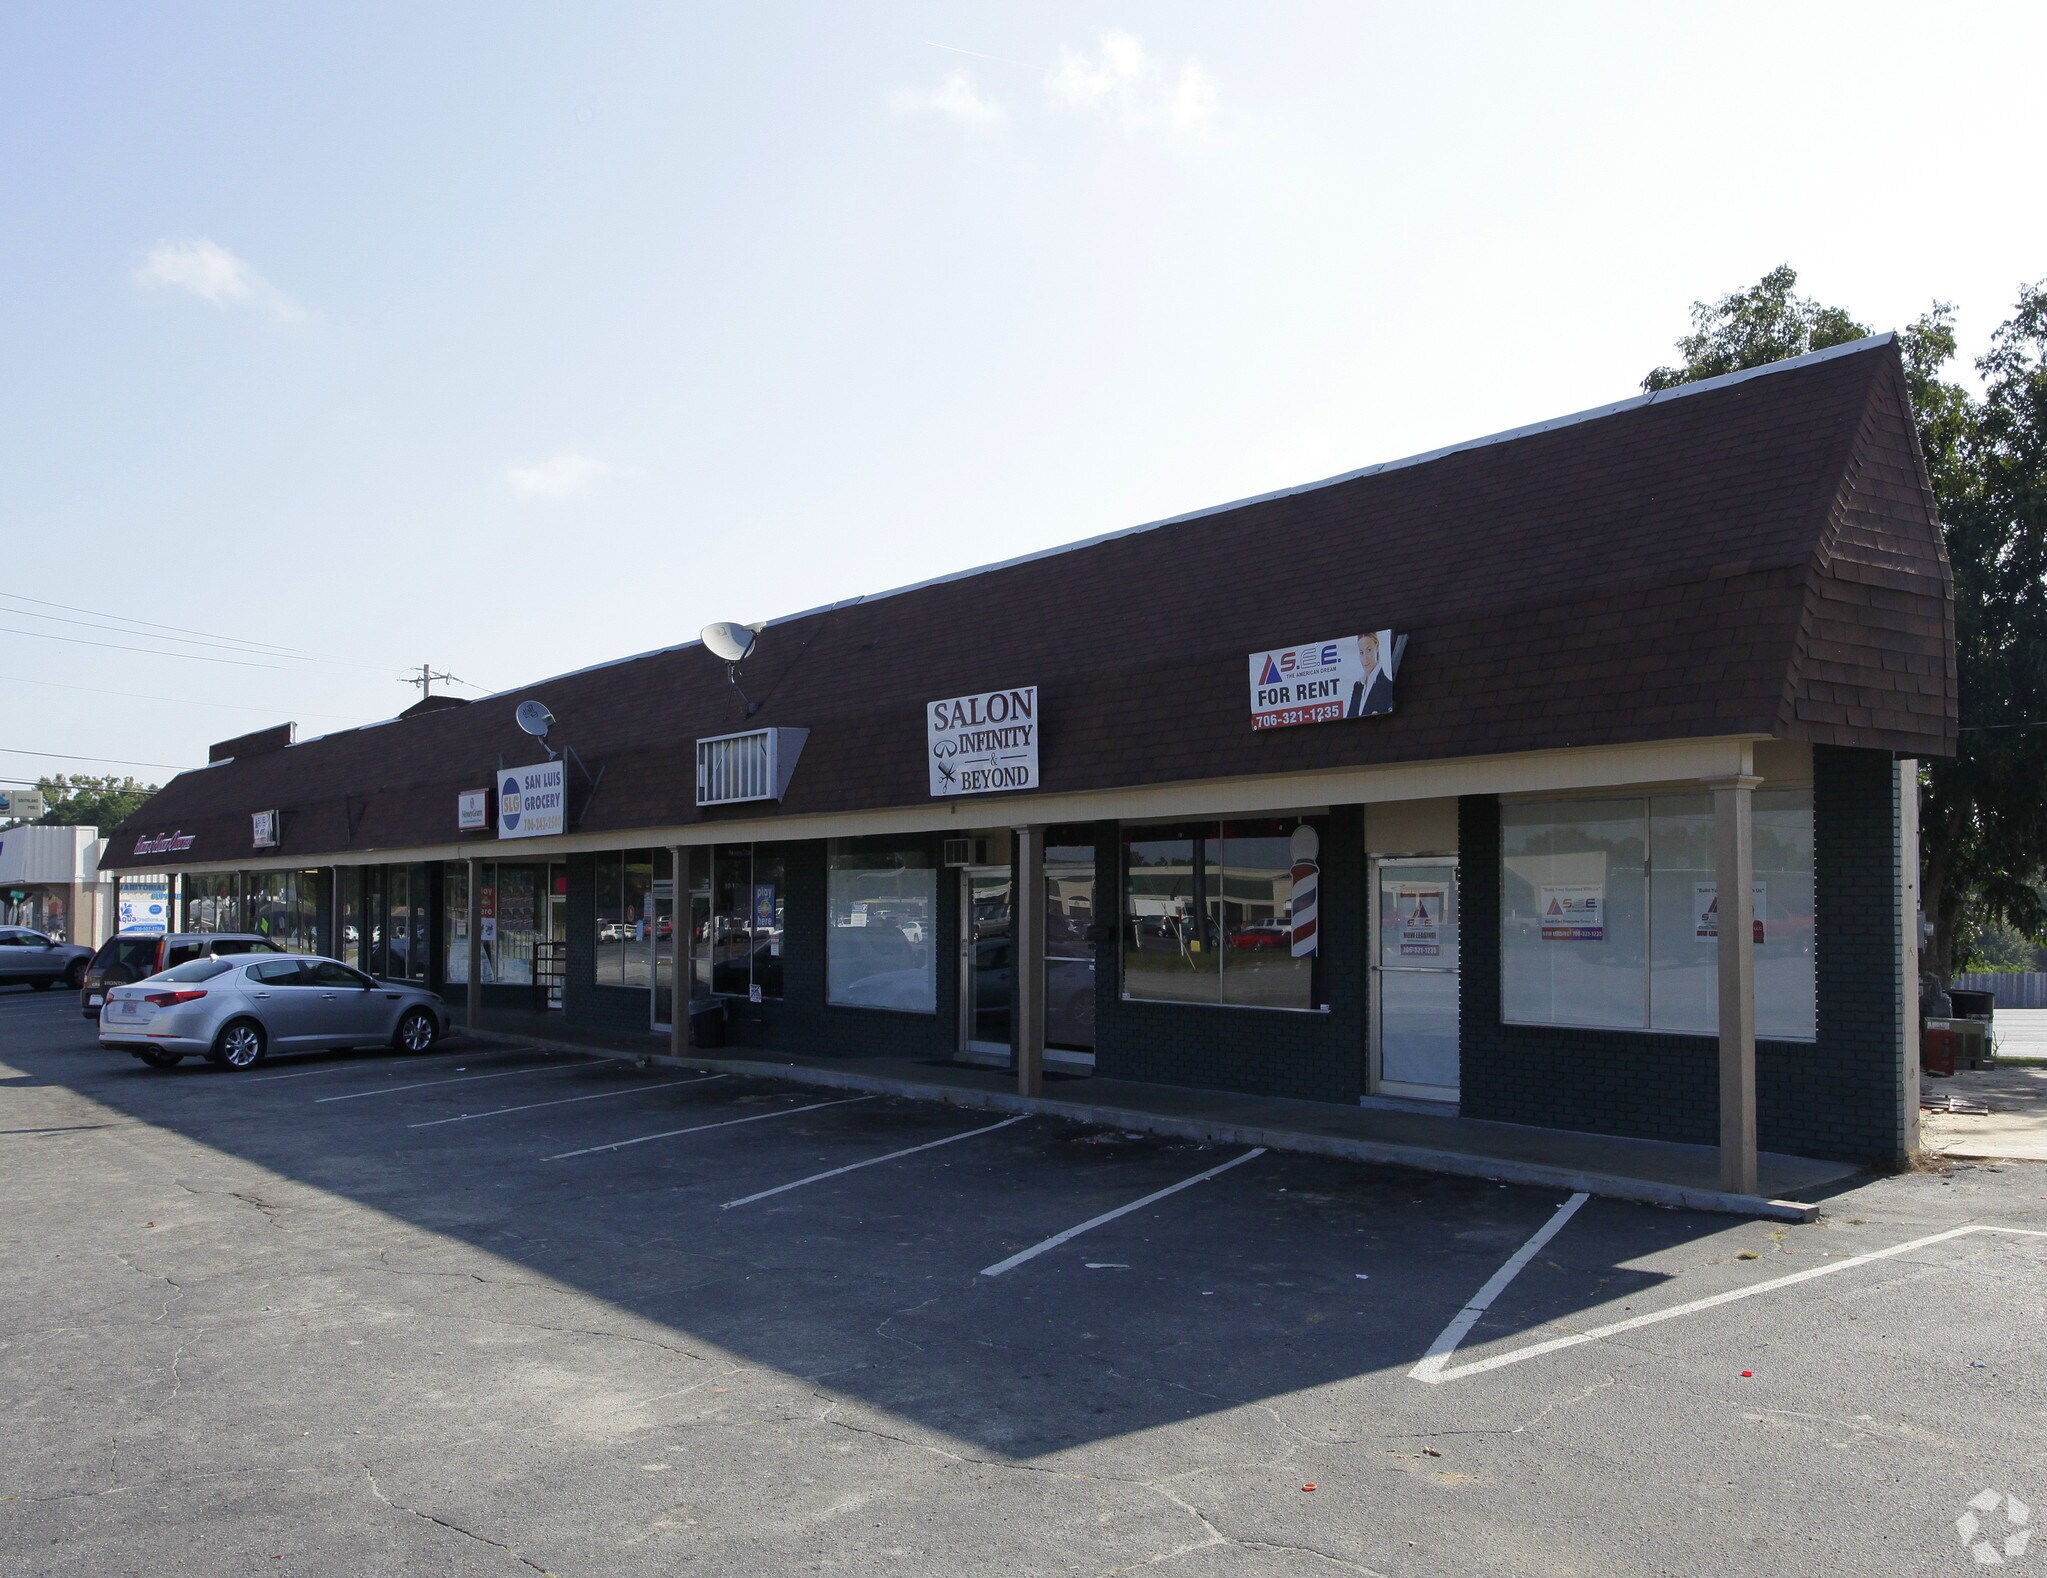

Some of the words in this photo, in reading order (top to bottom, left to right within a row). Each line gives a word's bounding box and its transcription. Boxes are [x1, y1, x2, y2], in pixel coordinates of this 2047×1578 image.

[1296, 669, 1320, 678] AMERICAN
[1320, 666, 1337, 675] DREAM
[1258, 686, 1290, 707] FOR
[1297, 678, 1340, 701] RENT
[934, 689, 1033, 732] SALON
[1256, 705, 1339, 728] 706-321-1235
[959, 724, 1033, 754] INFINITY
[990, 752, 998, 767] &
[525, 773, 541, 790] SAN
[543, 771, 561, 788] LUIS
[961, 765, 1029, 791] BEYOND
[504, 795, 520, 813] SLG
[525, 792, 561, 811] GROCERY
[481, 887, 493, 896] lay
[757, 887, 773, 899] play
[481, 907, 493, 915] ere
[757, 917, 772, 926] here
